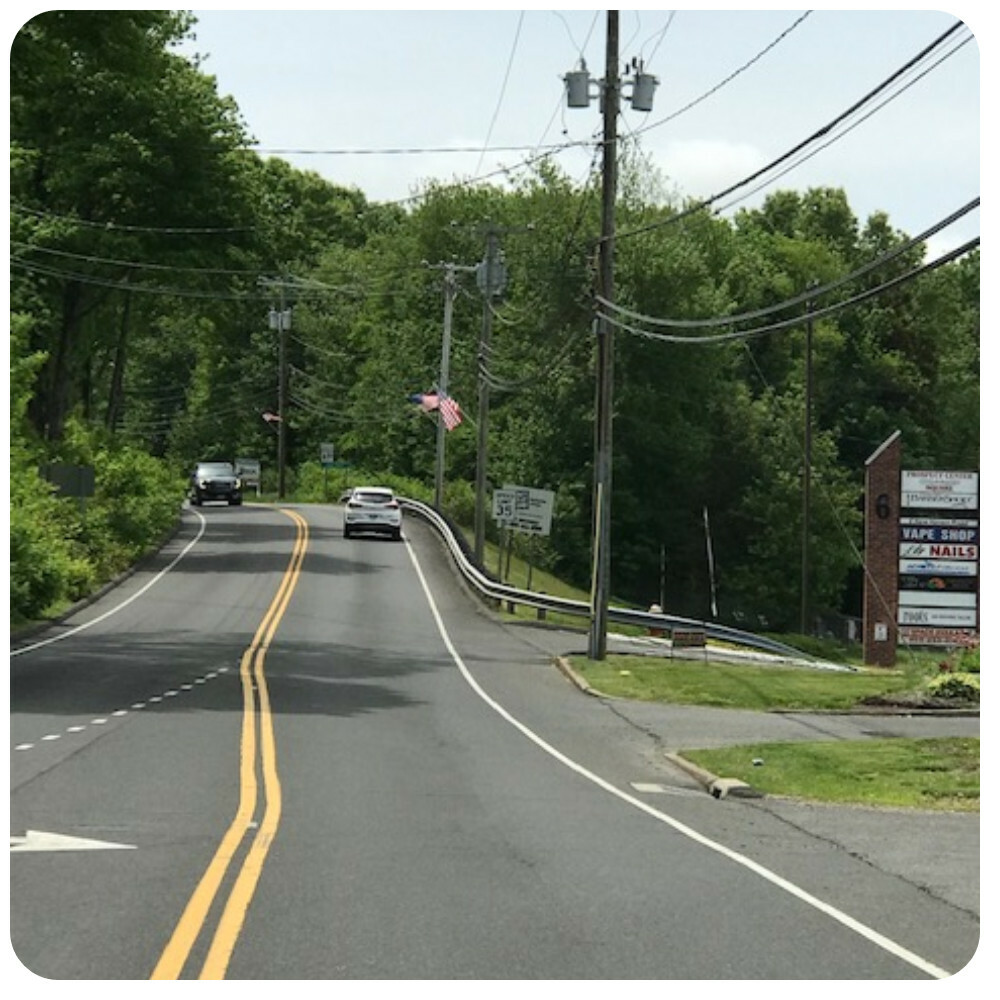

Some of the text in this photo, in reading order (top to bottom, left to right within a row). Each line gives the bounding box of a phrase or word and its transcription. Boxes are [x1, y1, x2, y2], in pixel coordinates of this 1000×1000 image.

[876, 494, 890, 519] 6
[902, 527, 976, 541] VAPE SHOP
[930, 545, 975, 557] NAILS
